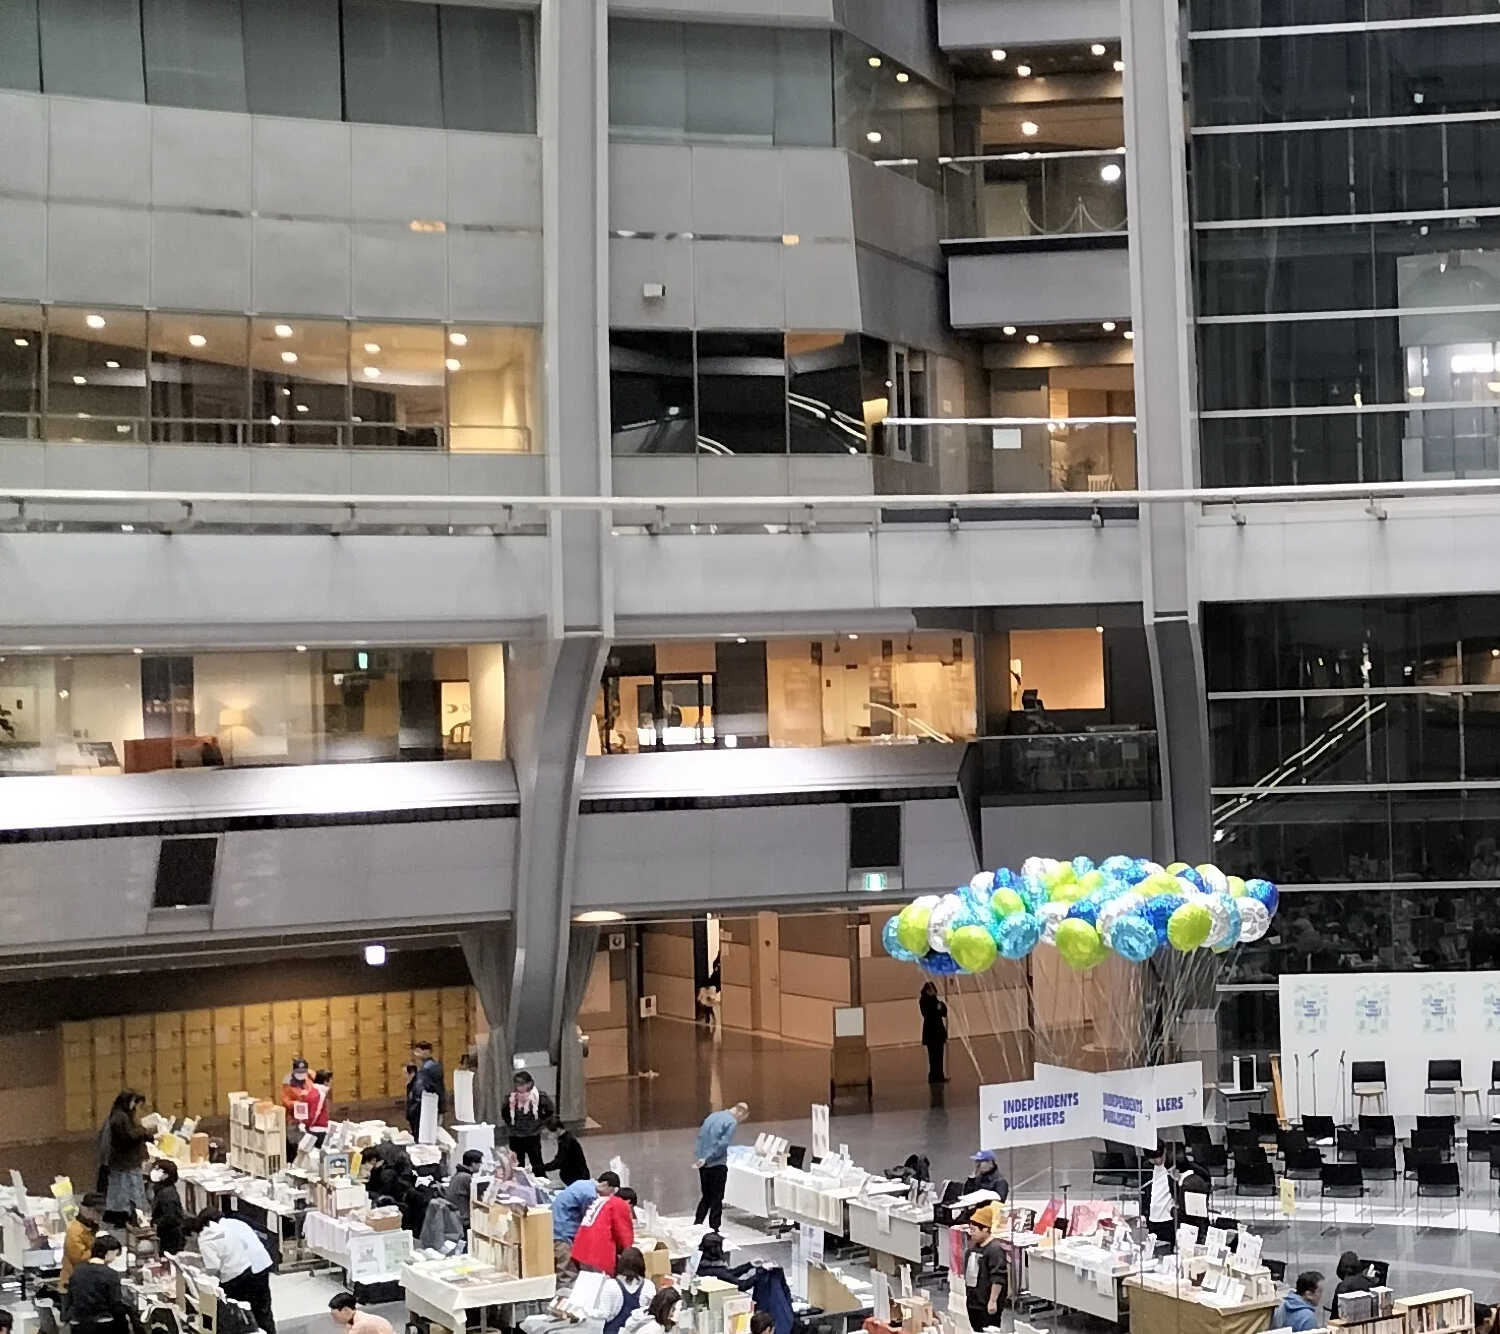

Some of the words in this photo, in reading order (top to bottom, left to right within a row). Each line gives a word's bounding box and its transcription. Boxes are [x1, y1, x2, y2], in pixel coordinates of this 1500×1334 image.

[1003, 1092, 1079, 1114] INDEPENDENTS
[1156, 1096, 1184, 1113] LLERS
[1003, 1110, 1066, 1131] PUBLISHERS
